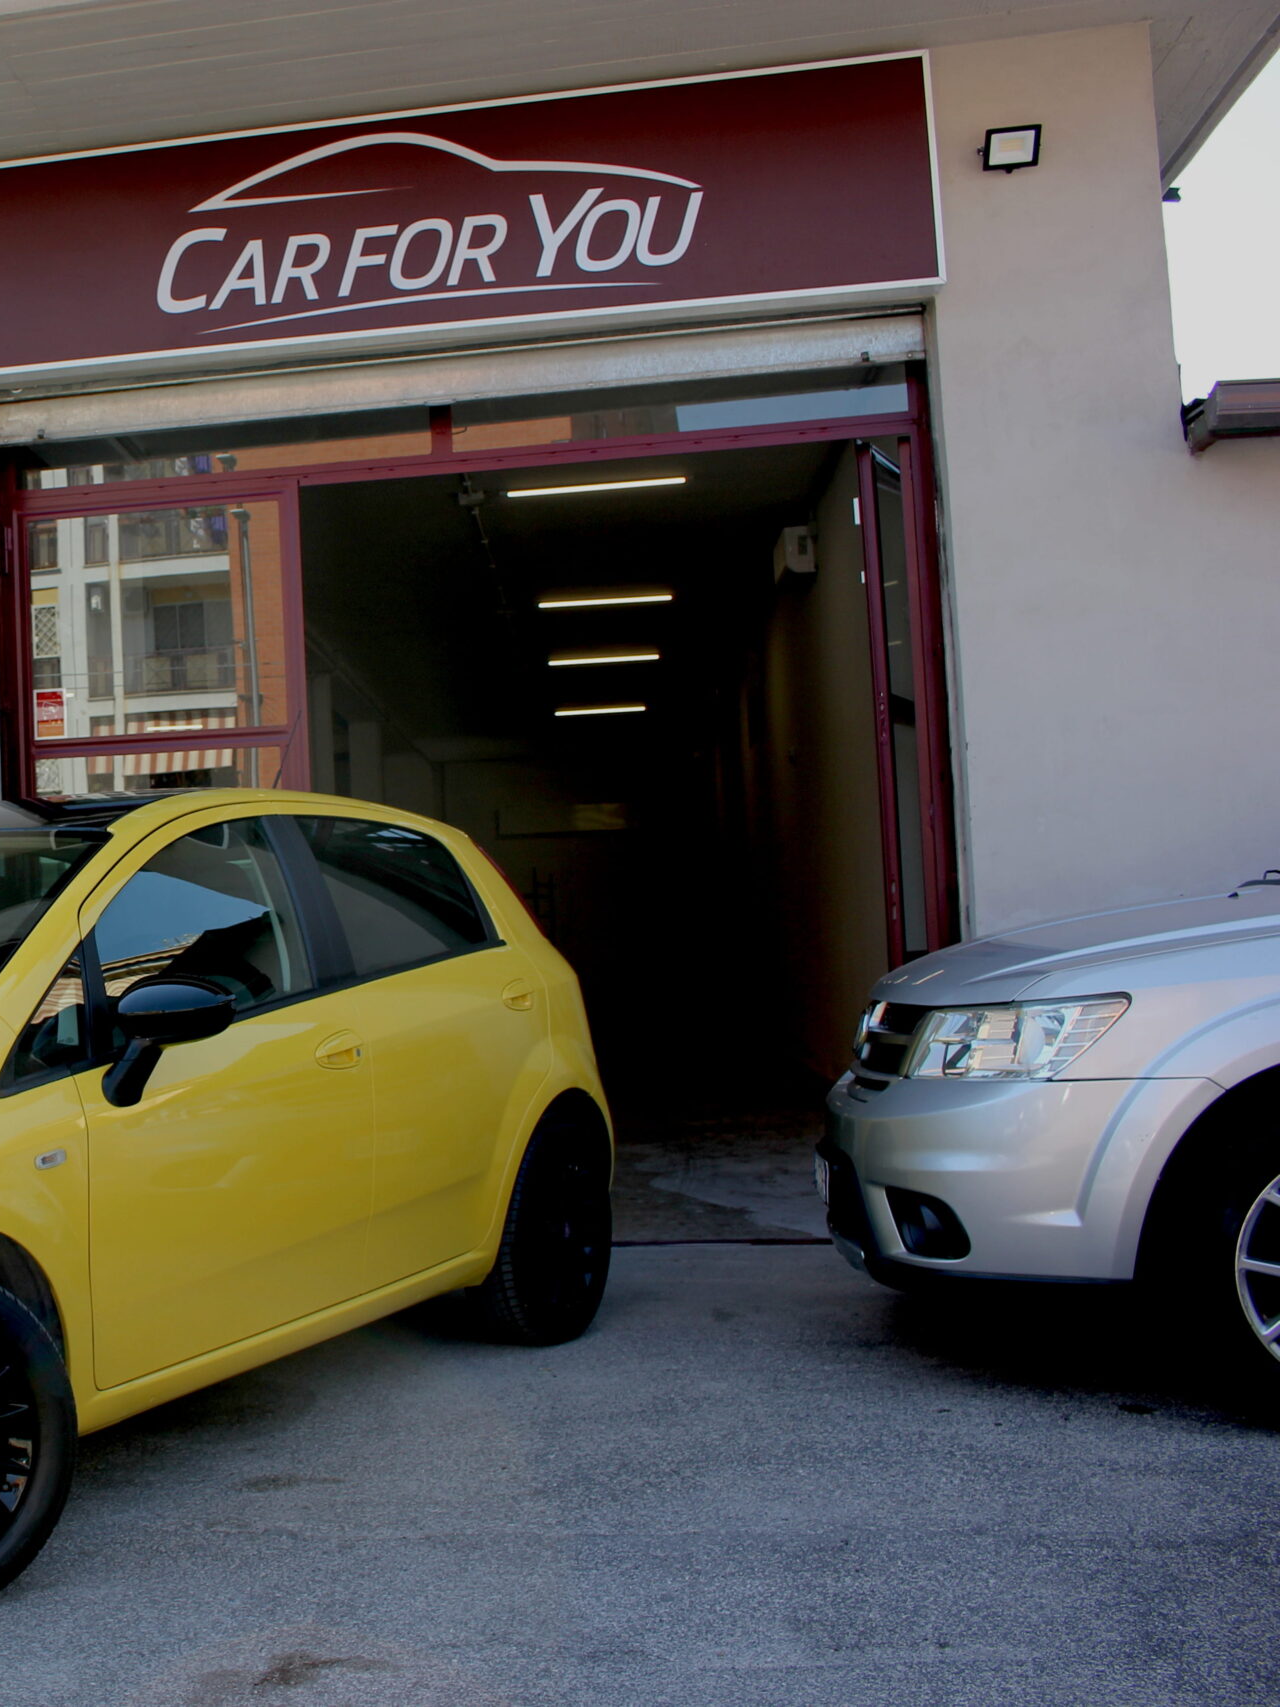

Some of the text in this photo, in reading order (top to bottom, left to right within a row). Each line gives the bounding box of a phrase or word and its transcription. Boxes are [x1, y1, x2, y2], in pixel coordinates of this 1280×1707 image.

[156, 187, 704, 314] CAR FOR YOU
